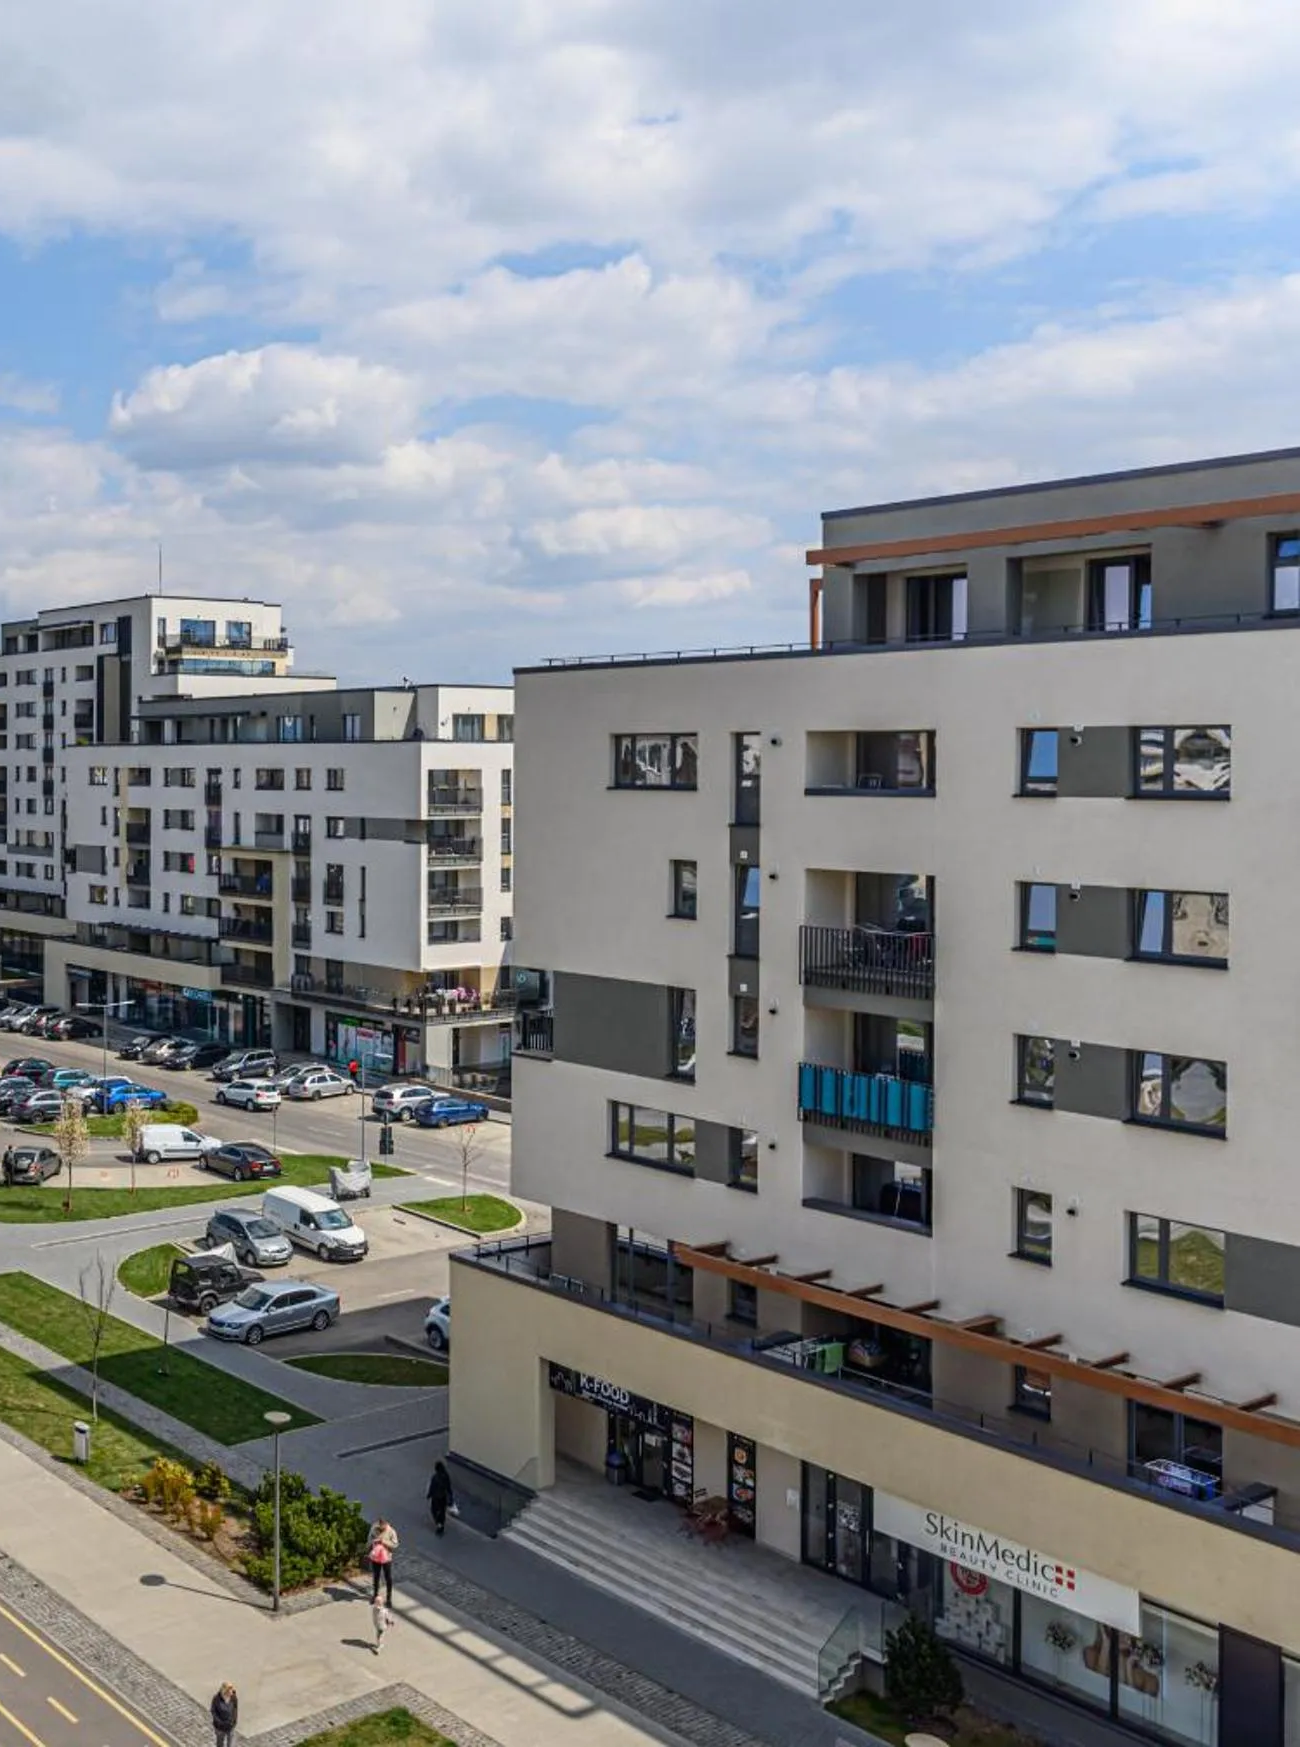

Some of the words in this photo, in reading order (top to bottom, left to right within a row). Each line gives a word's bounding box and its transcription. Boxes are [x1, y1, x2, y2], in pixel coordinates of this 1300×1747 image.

[580, 1374, 630, 1404] K-FOOD
[925, 1512, 1054, 1582] SkinMedic
[941, 1542, 997, 1571] BEAUTY
[1006, 1569, 1058, 1598] CLINIC
